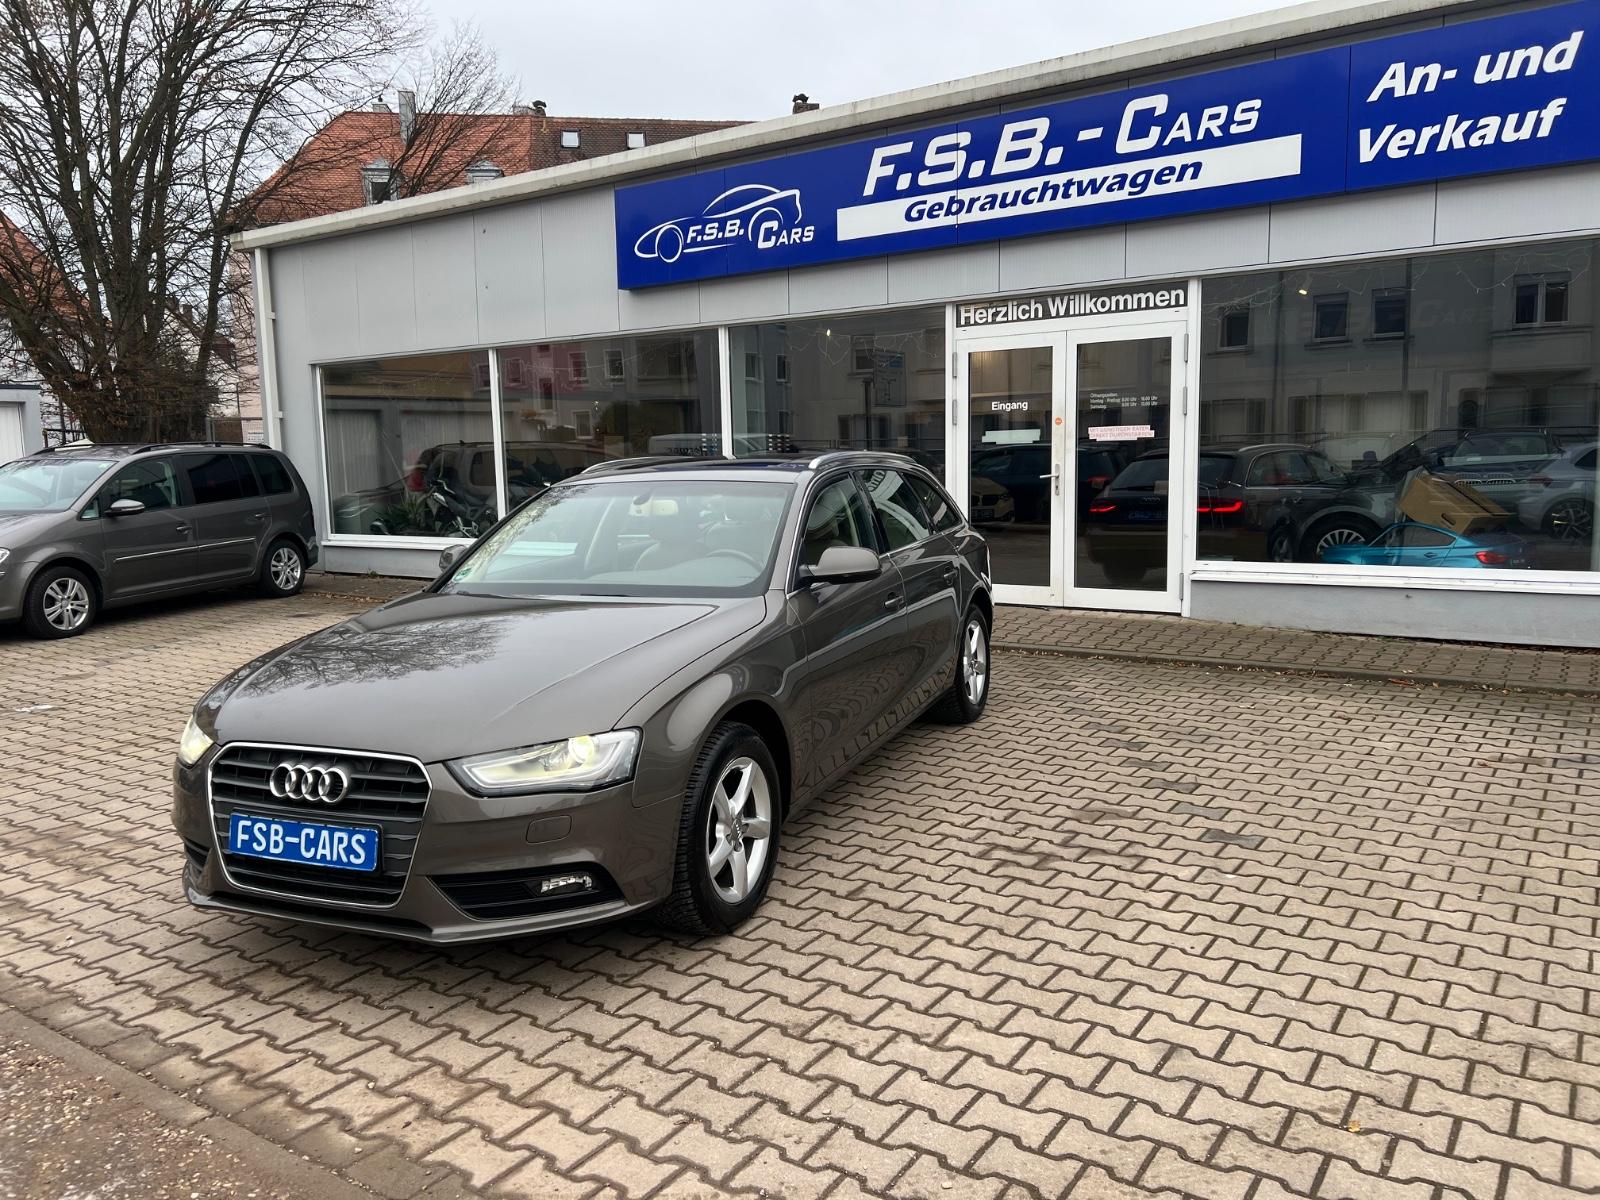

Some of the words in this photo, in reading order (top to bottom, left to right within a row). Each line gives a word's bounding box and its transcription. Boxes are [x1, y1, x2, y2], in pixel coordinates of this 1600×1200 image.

[1366, 62, 1458, 103] An-
[1474, 31, 1585, 85] und
[1359, 98, 1568, 163] Verkauf
[903, 159, 1203, 223] Gebrauchtwagen
[687, 219, 745, 244] F.S.B.
[960, 299, 1043, 326] Herzlich
[1048, 289, 1185, 317] Willkommen
[991, 400, 1029, 411] Eingang
[237, 819, 366, 866] FSB-CARS
